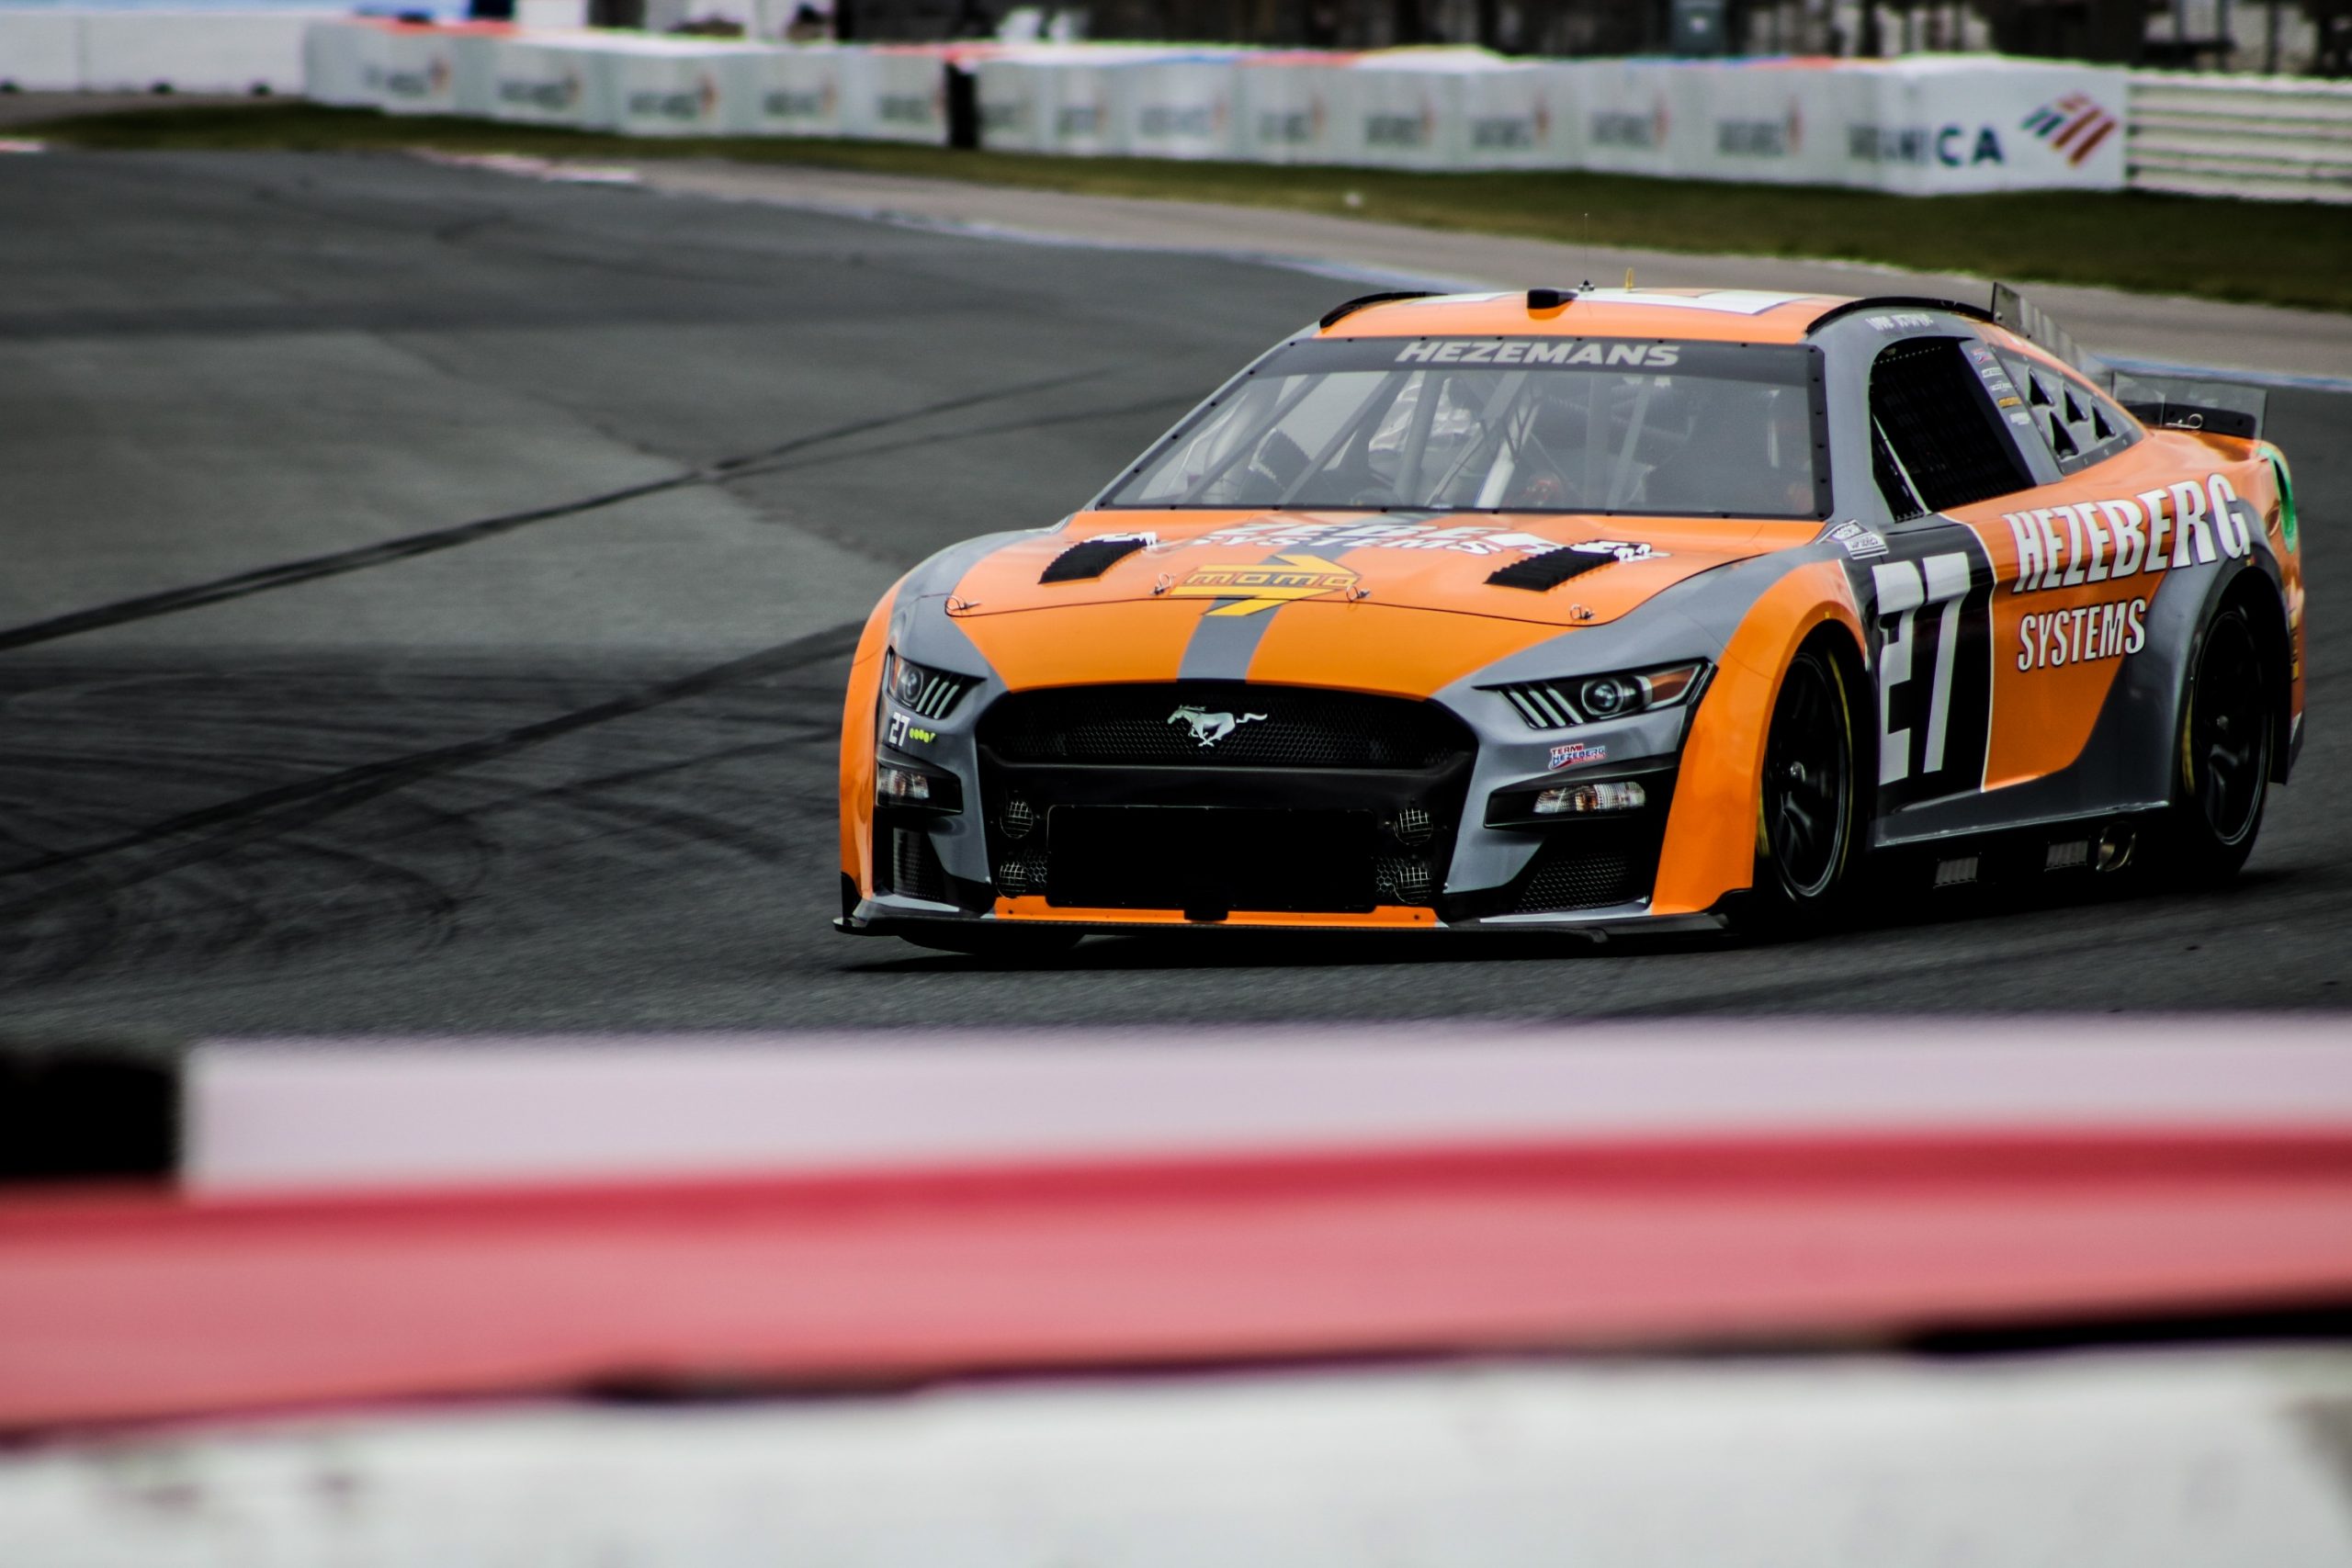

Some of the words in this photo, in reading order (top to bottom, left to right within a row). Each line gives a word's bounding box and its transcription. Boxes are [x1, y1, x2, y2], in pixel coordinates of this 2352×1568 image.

[1395, 341, 1679, 367] HEZEMANS
[2002, 473, 2251, 592] HEZEBERG
[1871, 551, 1972, 786] 27
[2018, 599, 2147, 671] SYSTEMS
[888, 711, 911, 747] 27
